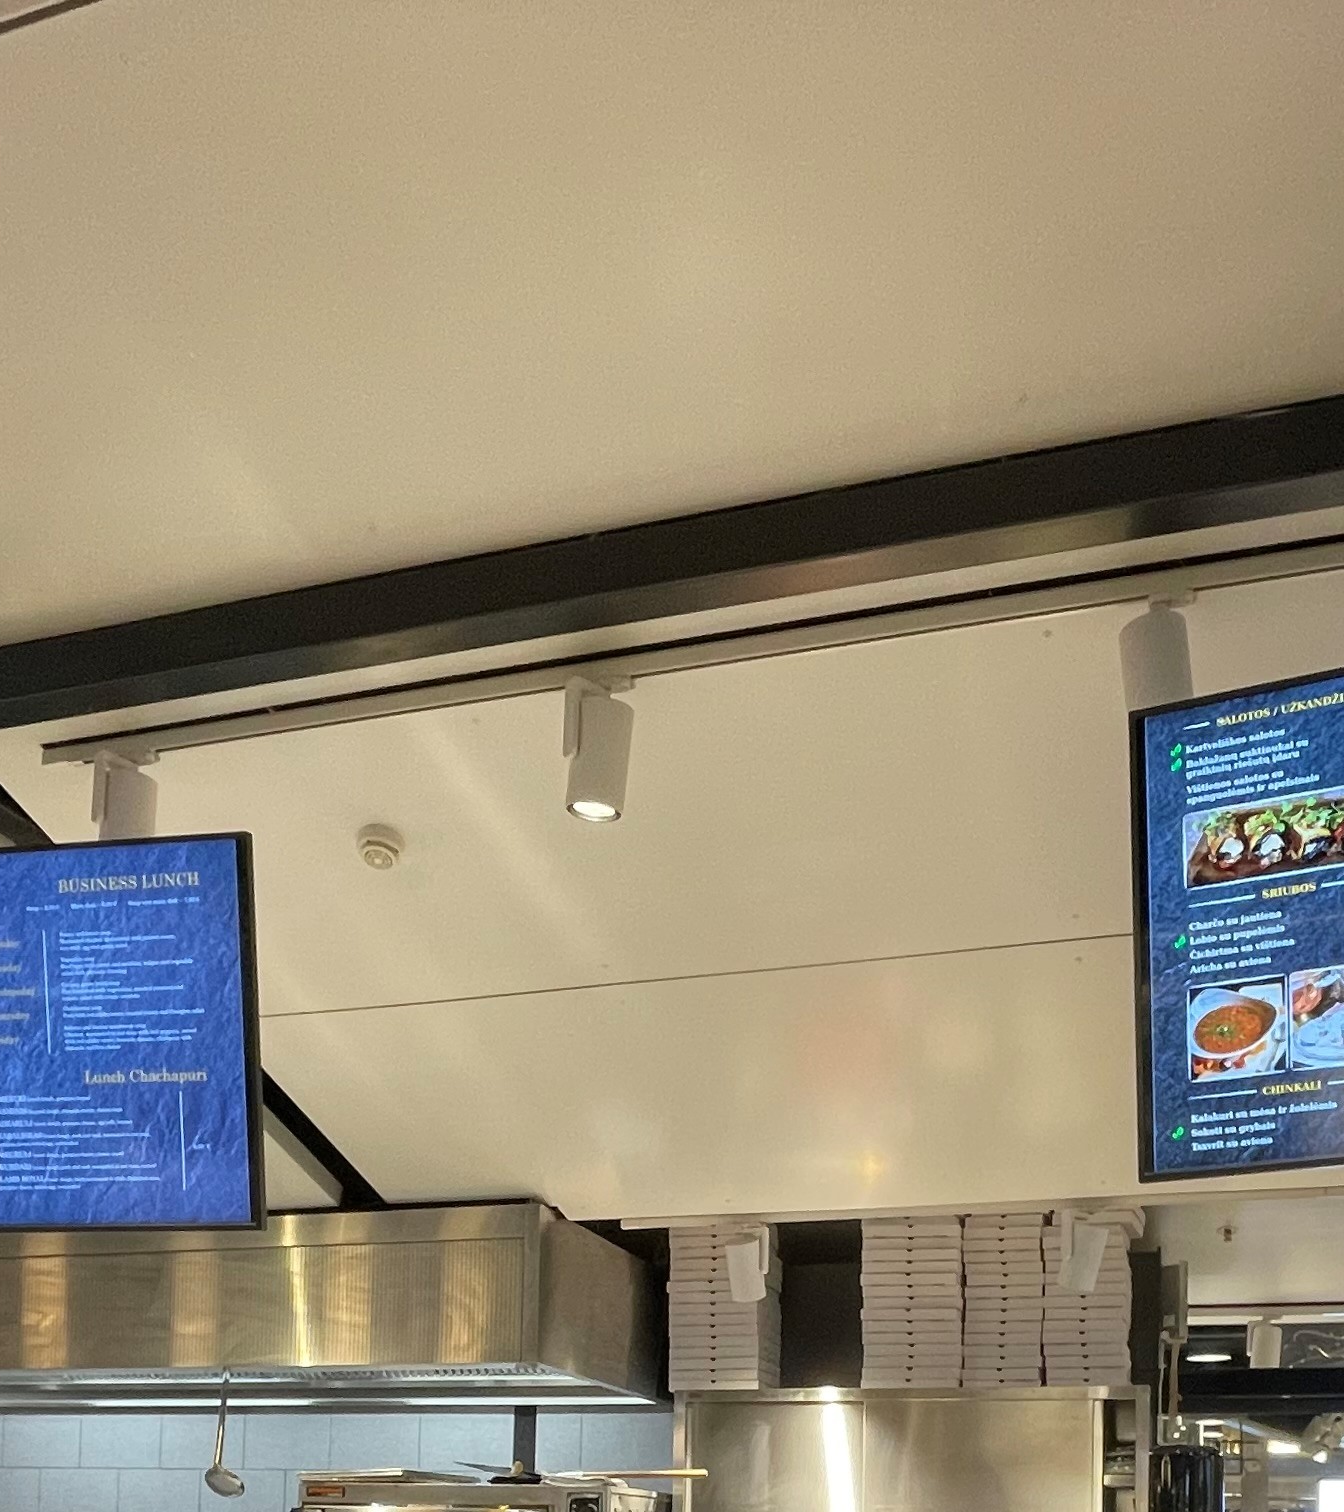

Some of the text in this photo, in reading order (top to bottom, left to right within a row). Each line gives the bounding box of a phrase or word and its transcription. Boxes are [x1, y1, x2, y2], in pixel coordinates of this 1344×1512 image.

[1216, 708, 1270, 727] SALOTOS
[1297, 739, 1309, 747] su
[1272, 770, 1284, 778] su
[1257, 783, 1265, 791] ir
[59, 871, 199, 894] BUSINESS LUNCH
[1262, 883, 1316, 899] SRIUBOS
[1227, 917, 1238, 926] su
[1220, 932, 1231, 941] su
[1241, 944, 1253, 952] su
[1225, 961, 1236, 969] su
[85, 1069, 208, 1084] Lunch Chachapuri
[1263, 1080, 1322, 1096] CHINKALI
[1278, 1106, 1286, 1114] ir
[1225, 1126, 1236, 1134] su
